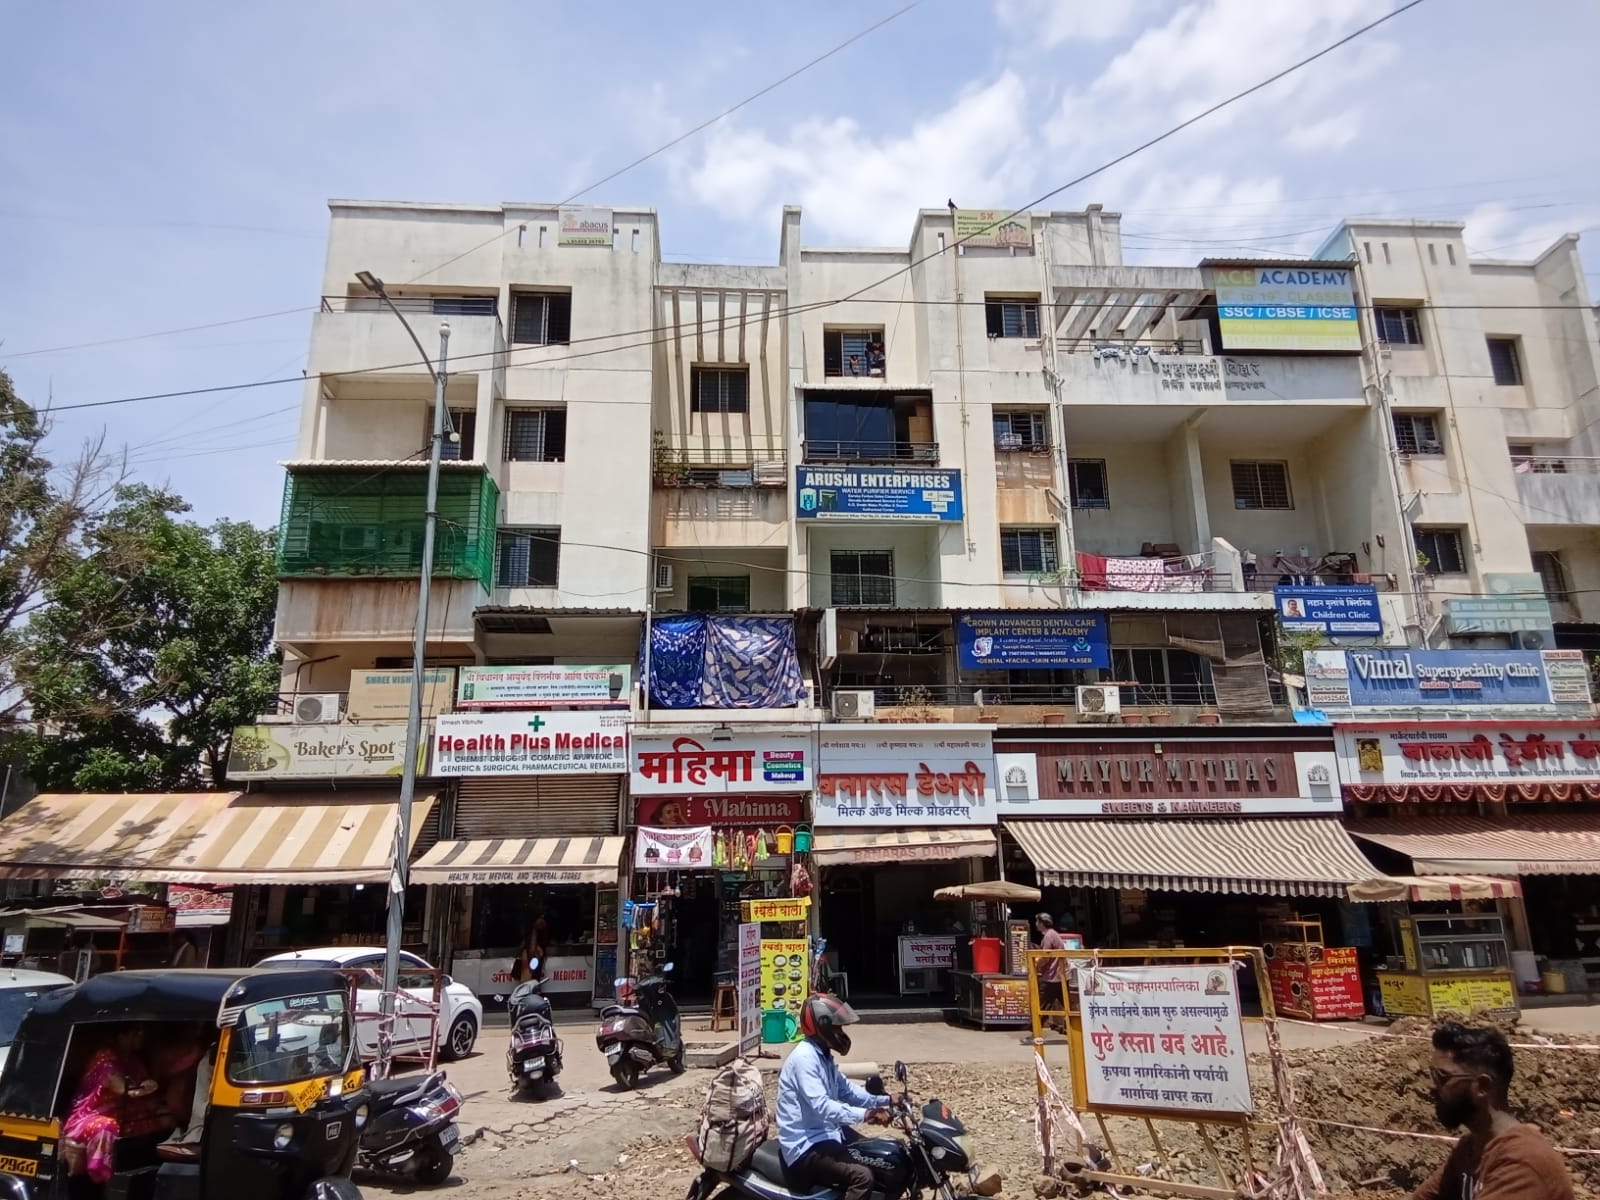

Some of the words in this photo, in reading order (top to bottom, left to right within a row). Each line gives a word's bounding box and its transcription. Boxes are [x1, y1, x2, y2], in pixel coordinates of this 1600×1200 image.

[1260, 271, 1347, 286] ACADEMY
[1224, 306, 1255, 318] SSC
[1266, 307, 1305, 318] CBSE
[1318, 307, 1352, 319] ICSE
[805, 473, 858, 487] ARUSHI
[861, 474, 950, 489] ENTERPRISES
[1325, 597, 1345, 610] मुलांचे
[1312, 611, 1346, 619] Children
[1348, 611, 1370, 619] Clinic
[967, 619, 997, 627] CROWN
[999, 619, 1042, 627] ADVANCED
[975, 628, 1009, 636] IMPLANT
[1011, 628, 1043, 636] CENTER
[1352, 653, 1415, 679] Vimal
[1416, 663, 1504, 681] Superspeciality
[1505, 663, 1540, 677] Clinic
[365, 676, 390, 684] SHREE
[293, 740, 355, 758] Baker's
[358, 740, 396, 758] Spot
[438, 734, 505, 752] Health
[510, 733, 550, 750] Plus
[555, 732, 629, 750] Medical
[1398, 733, 1494, 762] बालाजी
[455, 755, 488, 763] CHEMIST
[490, 754, 528, 762] DRUGGIST
[530, 754, 570, 762] COSMETIC
[572, 753, 613, 761] AYURVEDIC
[638, 737, 756, 786] महिमा
[770, 751, 795, 760] Beauty
[590, 763, 626, 771] RETAILERS
[1056, 758, 1154, 783] MAYUR
[1164, 757, 1278, 782] MITHAS
[771, 772, 797, 780] Makeup
[816, 773, 909, 797] बनारस
[915, 761, 986, 796] डेअरी
[703, 799, 791, 818] Mahima
[838, 805, 865, 817] मिल्क
[896, 804, 923, 817] मिल्क
[1101, 802, 1154, 813] SWEETS
[1158, 803, 1167, 813] &
[1170, 801, 1242, 812] NAMKEENS
[854, 848, 916, 862] BANARAS
[922, 846, 961, 858] DAIRY
[448, 873, 469, 881] HEALTH
[472, 873, 486, 881] PLUS
[488, 872, 514, 880] MEDICAL
[517, 872, 529, 880] AND
[532, 872, 557, 880] GENERAL
[559, 872, 581, 880] STORES
[780, 904, 802, 917] वाला
[553, 970, 587, 981] MEDICINE
[1127, 977, 1200, 993] महानगरपालिका
[1110, 1002, 1140, 1021] लाईनचे
[1141, 1006, 1160, 1018] काम
[1180, 1002, 1229, 1021] असल्यामुळे
[1090, 1024, 1114, 1060] पुढे
[1118, 1032, 1156, 1054] रस्ता
[1160, 1025, 1185, 1055] बंद
[1191, 1025, 1235, 1057] आहे.
[1102, 1066, 1131, 1082] कृपया
[1133, 1064, 1190, 1081] नागरिकांनी
[1193, 1065, 1229, 1082] पर्यायी
[1119, 1084, 1159, 1101] मार्गाचा
[1161, 1090, 1188, 1102] वापर
[1191, 1091, 1213, 1103] करा
